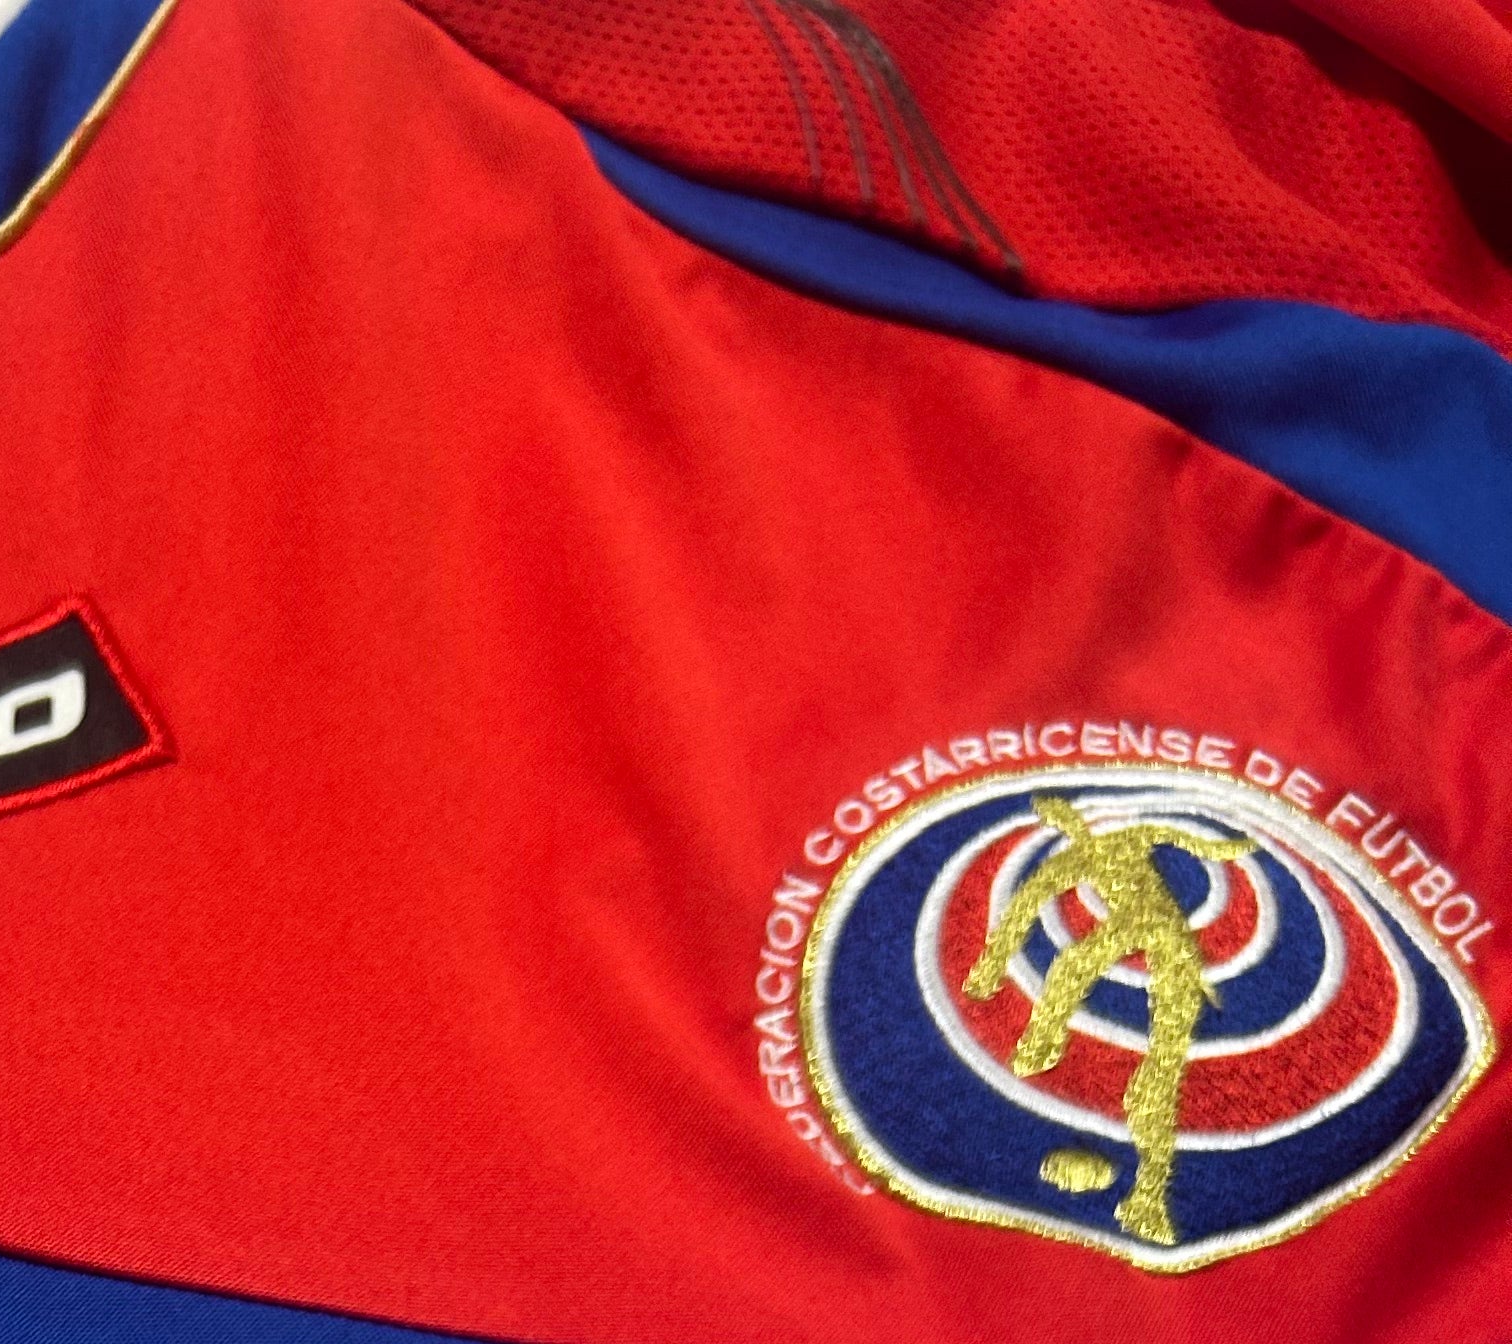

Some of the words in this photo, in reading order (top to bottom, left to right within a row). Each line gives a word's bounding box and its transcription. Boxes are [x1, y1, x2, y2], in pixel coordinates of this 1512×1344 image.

[803, 719, 1236, 866] COSTARRICENSE
[1244, 749, 1325, 810] DE
[1325, 792, 1494, 964] FUTBOL
